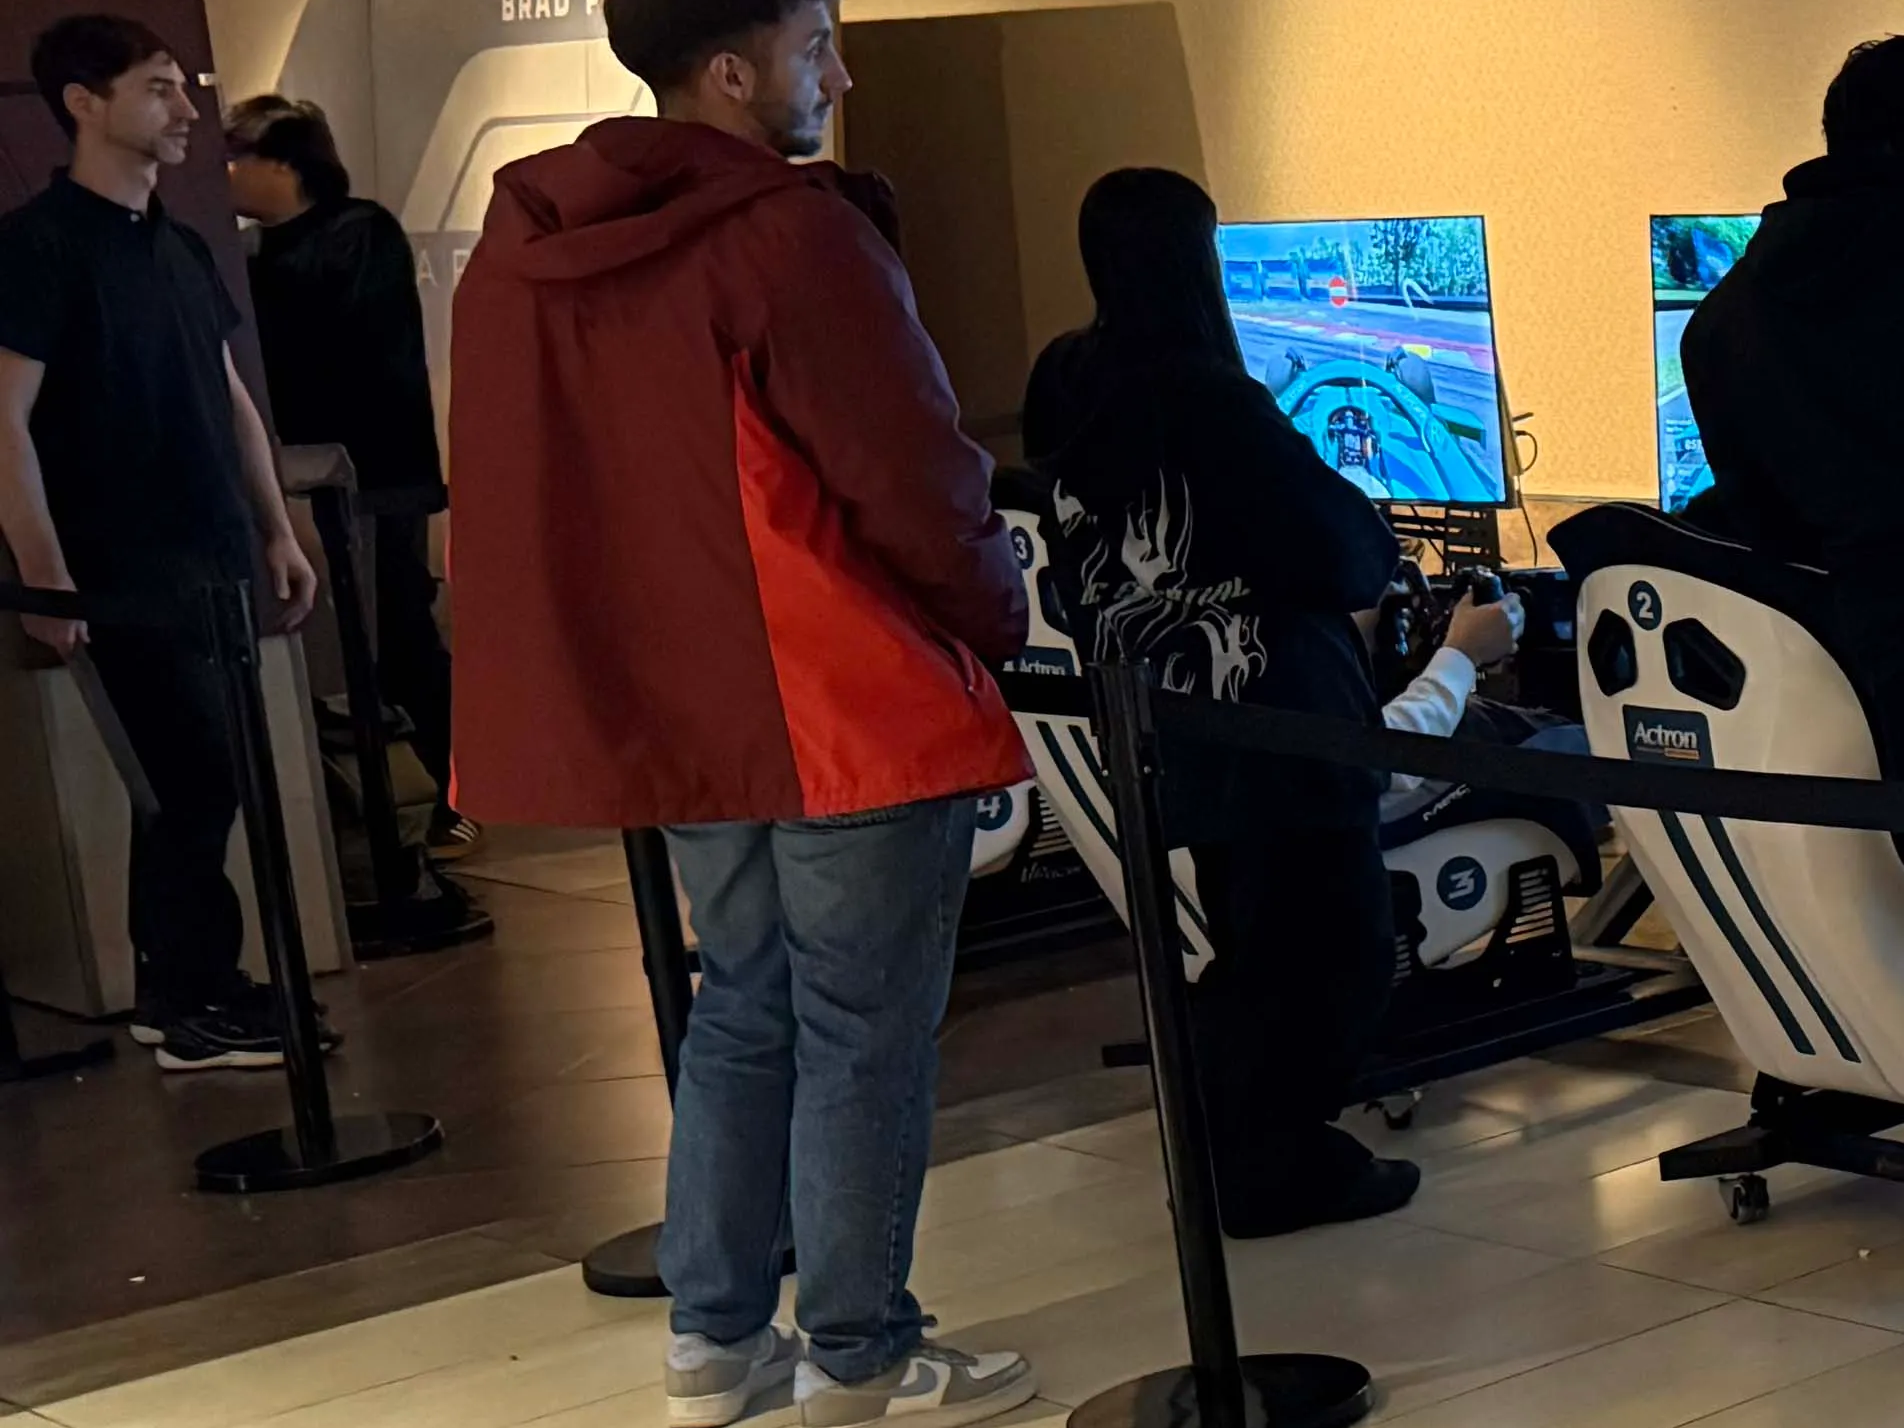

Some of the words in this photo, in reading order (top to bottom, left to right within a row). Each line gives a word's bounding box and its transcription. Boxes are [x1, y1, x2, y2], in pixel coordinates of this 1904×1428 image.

[1014, 536, 1027, 560] 3
[1636, 591, 1654, 619] 2
[1634, 721, 1698, 748] Actron
[1449, 868, 1477, 900] 3
